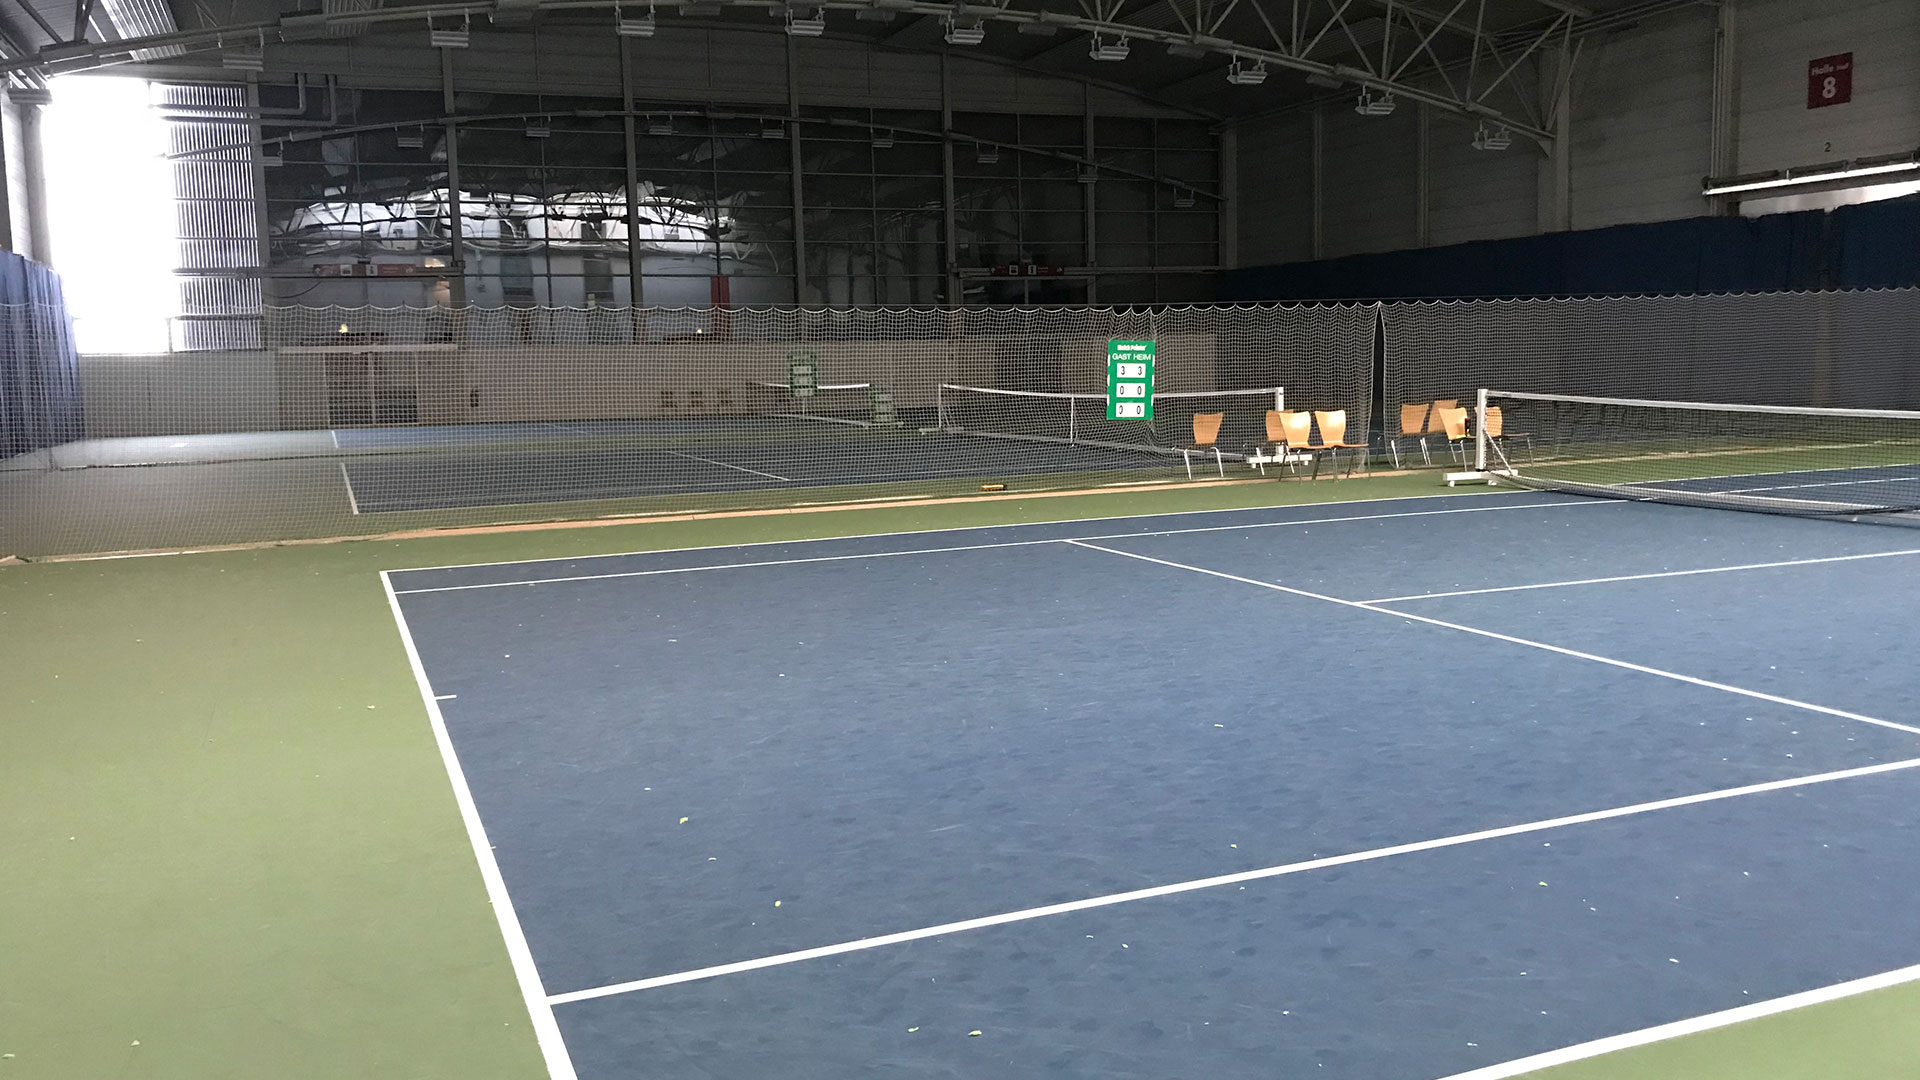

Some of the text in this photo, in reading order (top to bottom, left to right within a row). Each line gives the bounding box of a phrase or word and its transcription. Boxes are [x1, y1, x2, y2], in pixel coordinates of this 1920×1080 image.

[1811, 63, 1834, 76] Halle
[1822, 76, 1836, 98] 8
[1824, 142, 1831, 152] 2
[1120, 366, 1142, 375] 3 3
[1120, 385, 1142, 395] 0 0
[1136, 405, 1141, 415] 0
